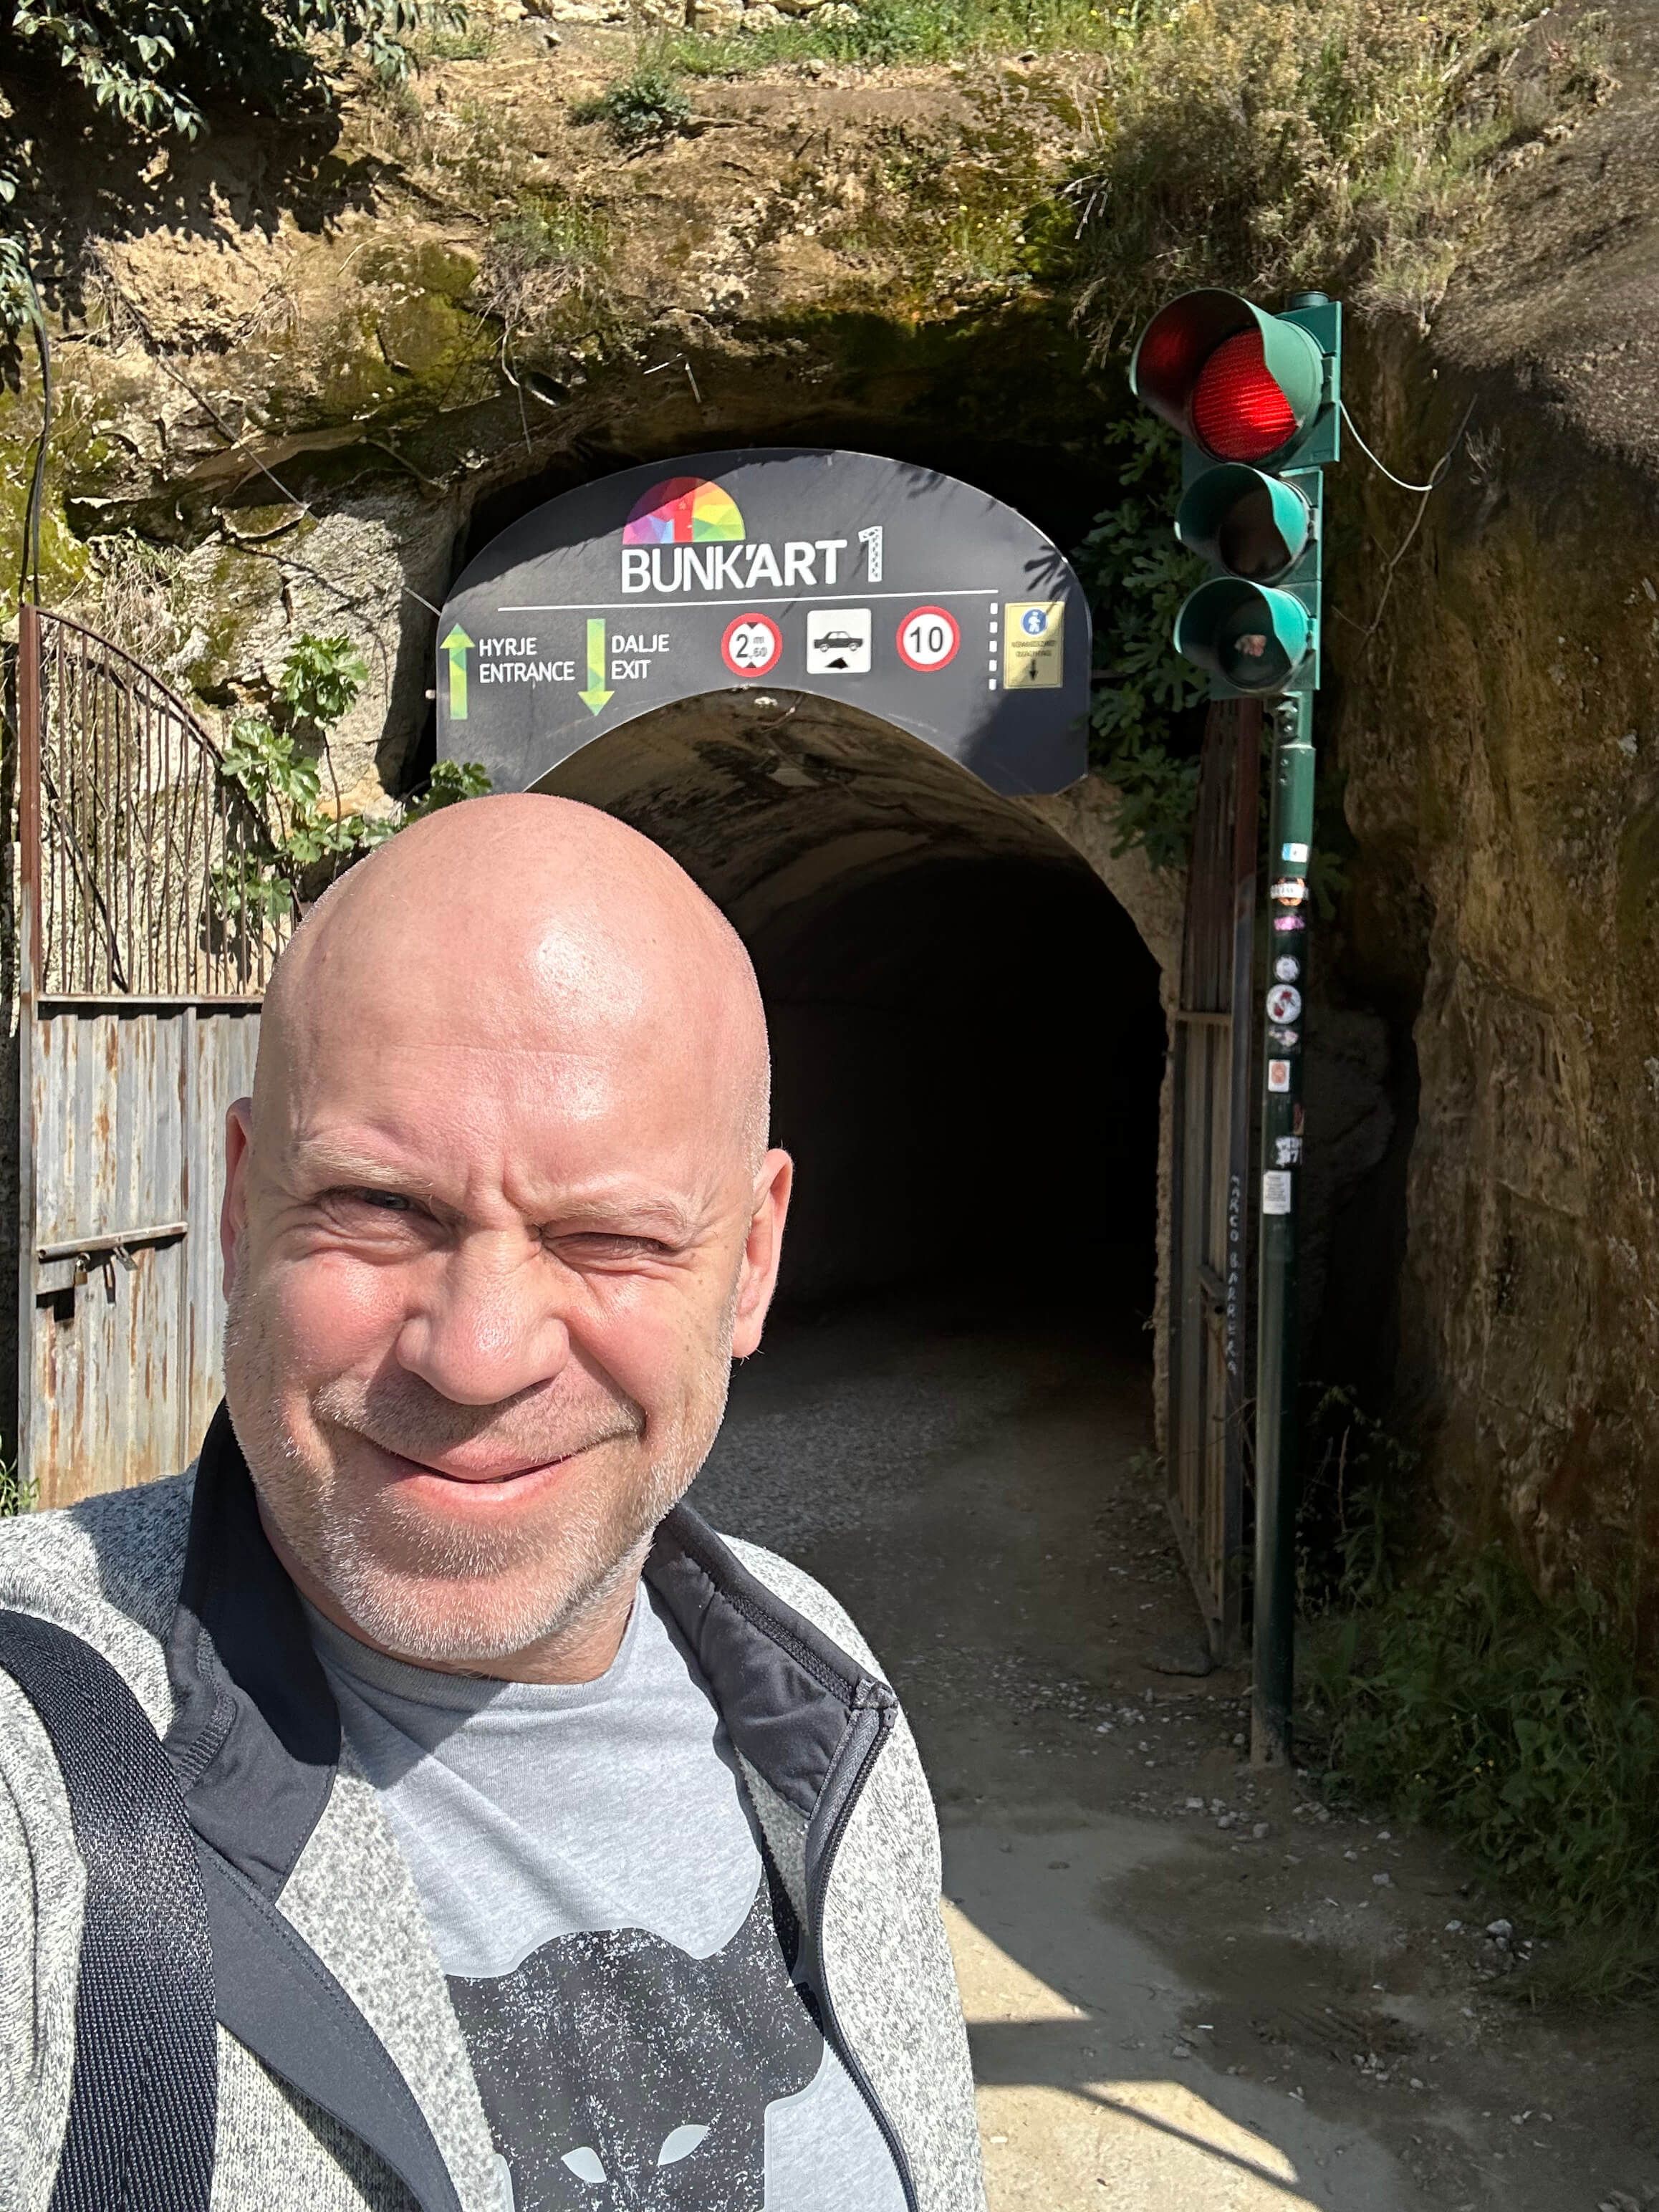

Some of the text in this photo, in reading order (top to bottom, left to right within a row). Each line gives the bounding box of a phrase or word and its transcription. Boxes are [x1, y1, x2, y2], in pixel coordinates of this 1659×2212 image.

[621, 525, 883, 594] BUNK'ART 1
[479, 637, 537, 657] HYRJE
[611, 633, 670, 653] DALJE
[910, 626, 943, 653] 10
[479, 661, 575, 683] ENTRANCE
[611, 659, 651, 680] EXIT
